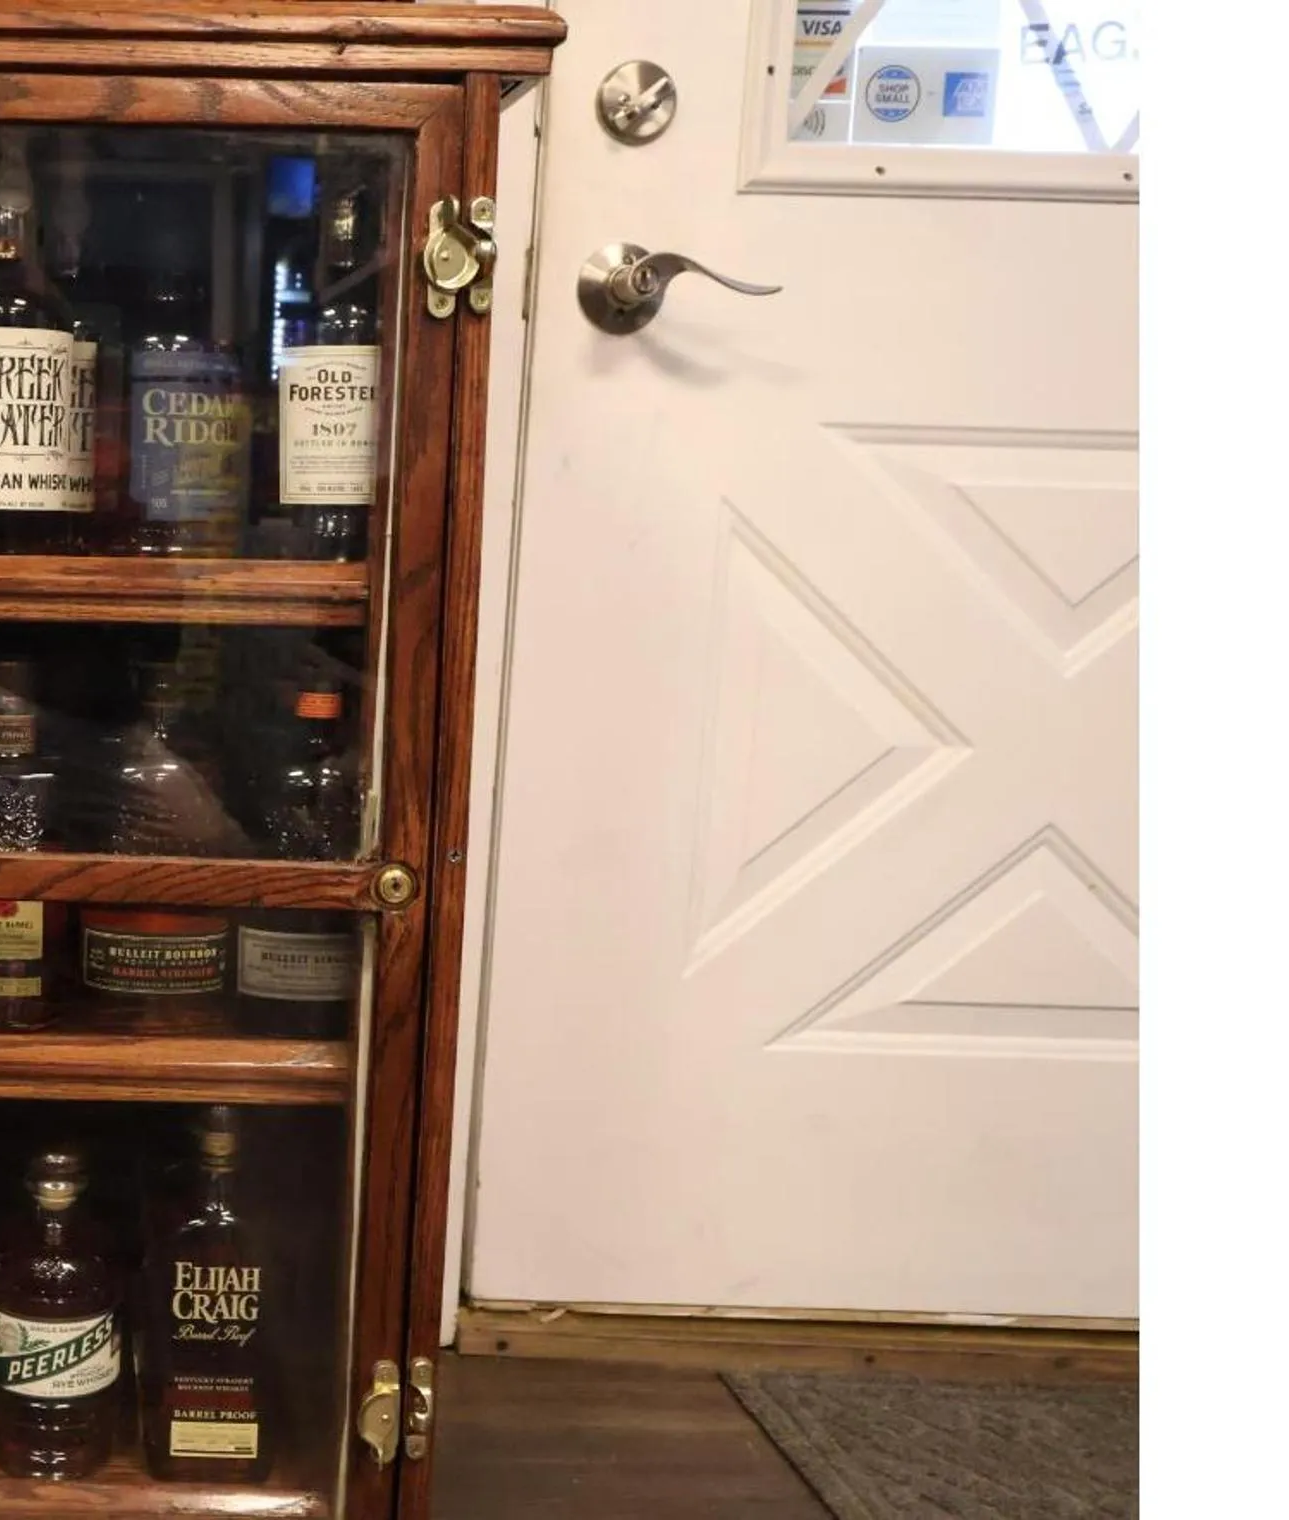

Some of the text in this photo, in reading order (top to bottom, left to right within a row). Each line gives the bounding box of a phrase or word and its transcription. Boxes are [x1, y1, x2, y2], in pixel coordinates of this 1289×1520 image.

[801, 20, 842, 35] VISA
[1021, 20, 1139, 64] EAG
[317, 369, 352, 383] OLD
[109, 947, 159, 960] BULLEIT
[173, 1261, 262, 1295] ELIJAH
[172, 1290, 259, 1323] CRAIG
[8, 1312, 114, 1382] PEERLESS
[174, 1410, 257, 1420] BARREL PROOF
